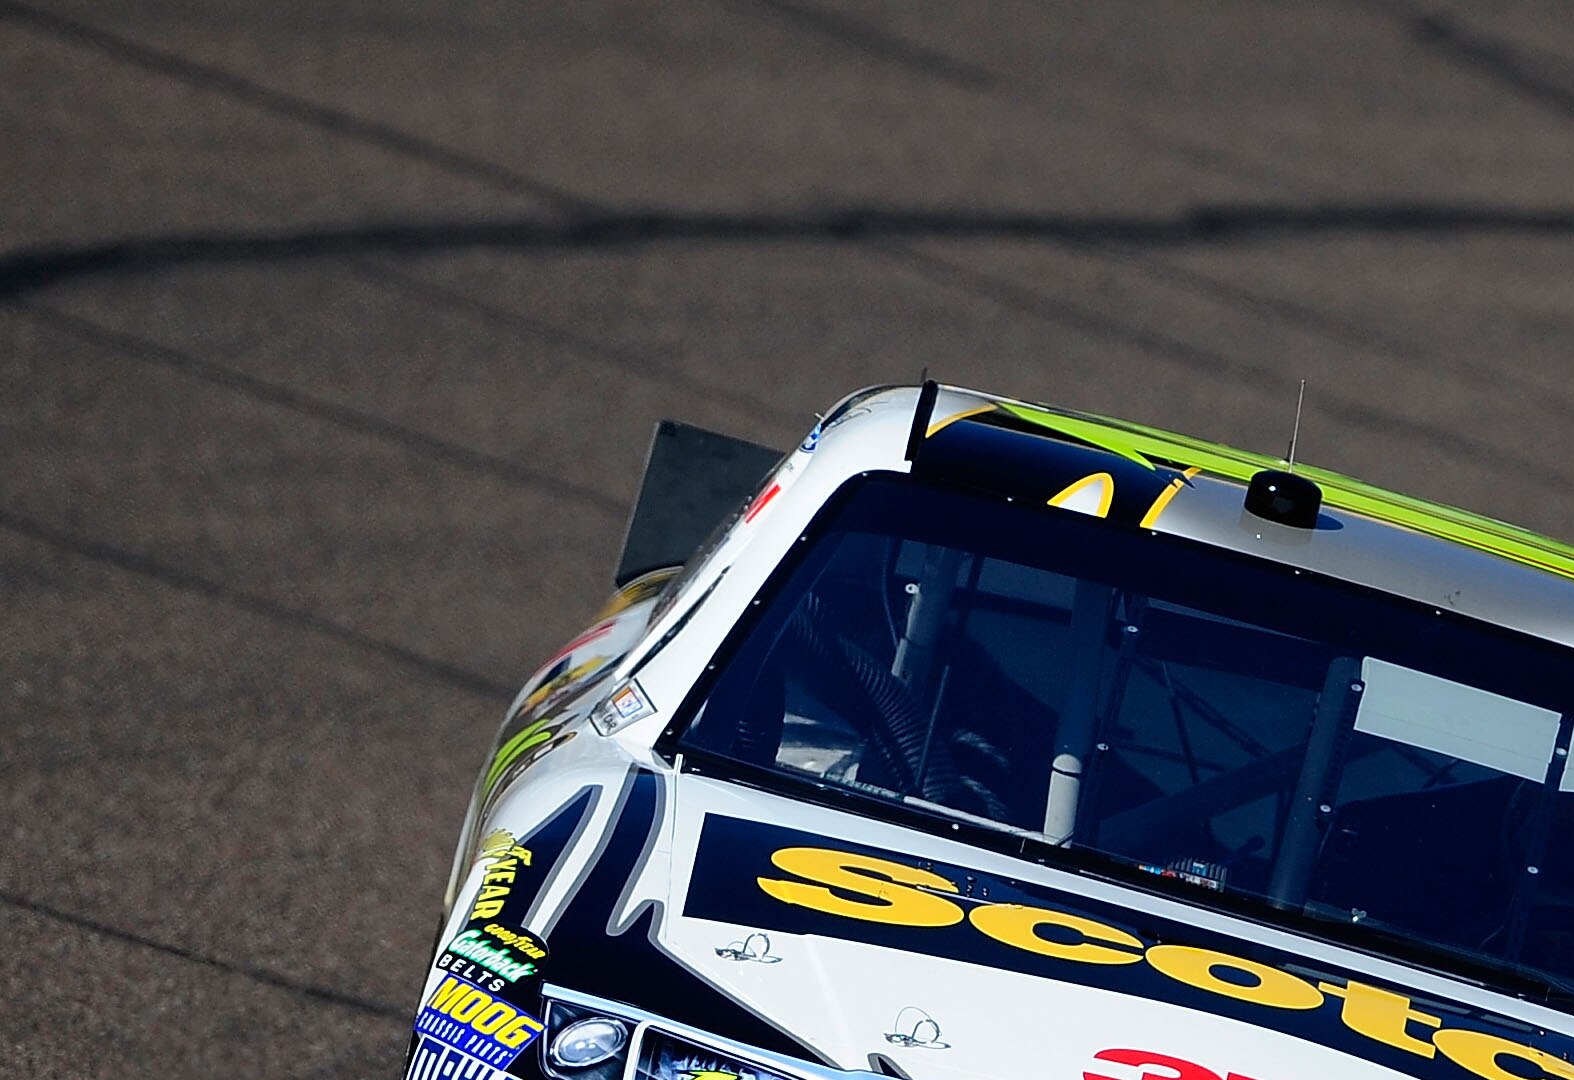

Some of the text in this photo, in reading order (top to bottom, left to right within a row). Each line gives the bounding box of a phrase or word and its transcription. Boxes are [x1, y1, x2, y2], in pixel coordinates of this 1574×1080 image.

[438, 954, 505, 992] BELTS
[448, 929, 535, 983] Gatorback
[418, 1011, 509, 1065] CHASSIS PARTS
[431, 977, 545, 1049] MOOG
